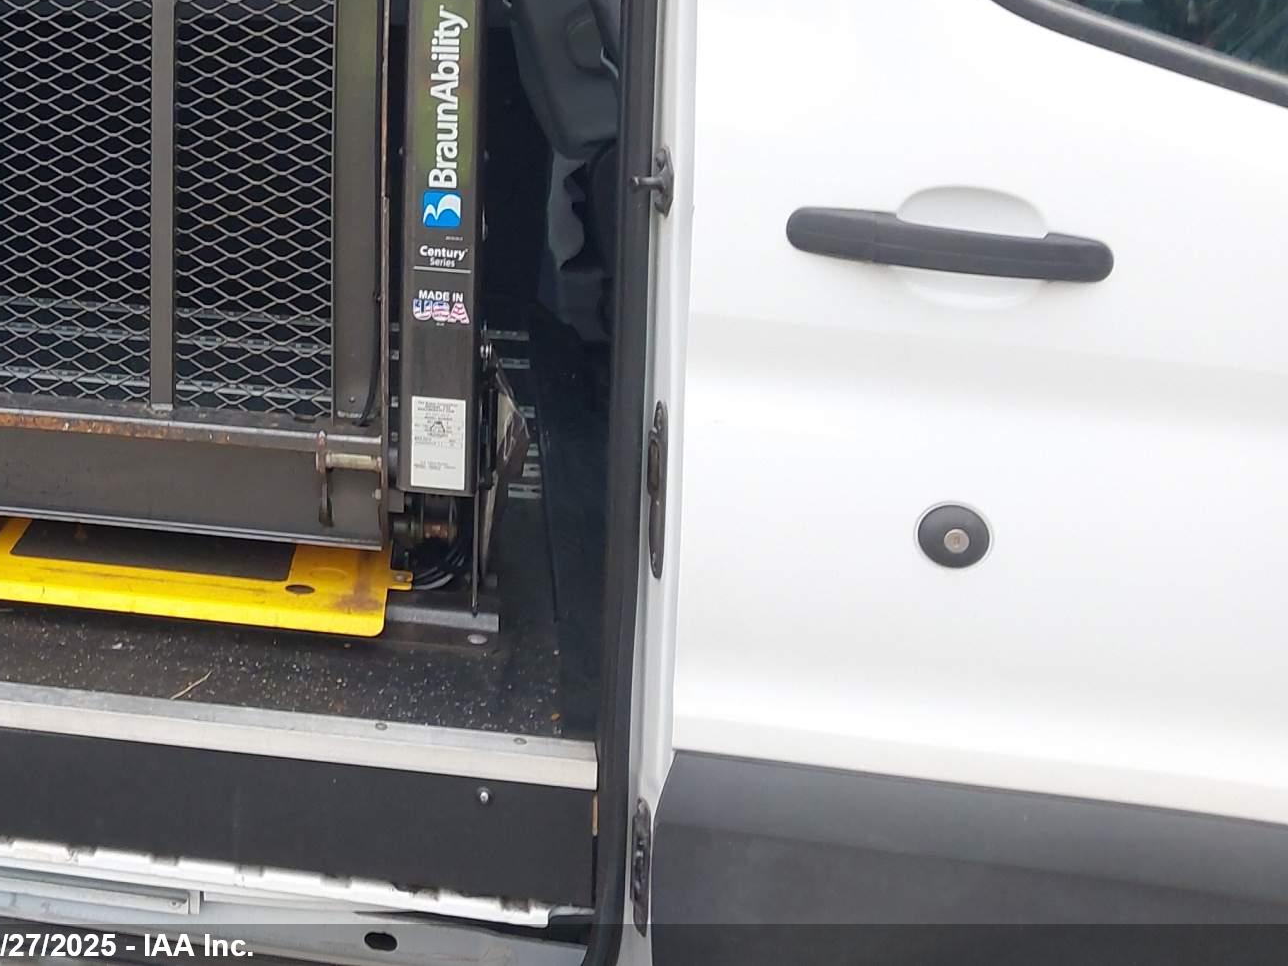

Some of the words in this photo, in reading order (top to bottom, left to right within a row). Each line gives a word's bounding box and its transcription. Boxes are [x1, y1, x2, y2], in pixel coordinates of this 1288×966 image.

[428, 9, 468, 189] BraunAbility
[419, 245, 466, 261] Century
[429, 257, 456, 268] Series
[418, 289, 450, 301] MADE
[452, 292, 464, 302] IN
[412, 298, 470, 324] USA
